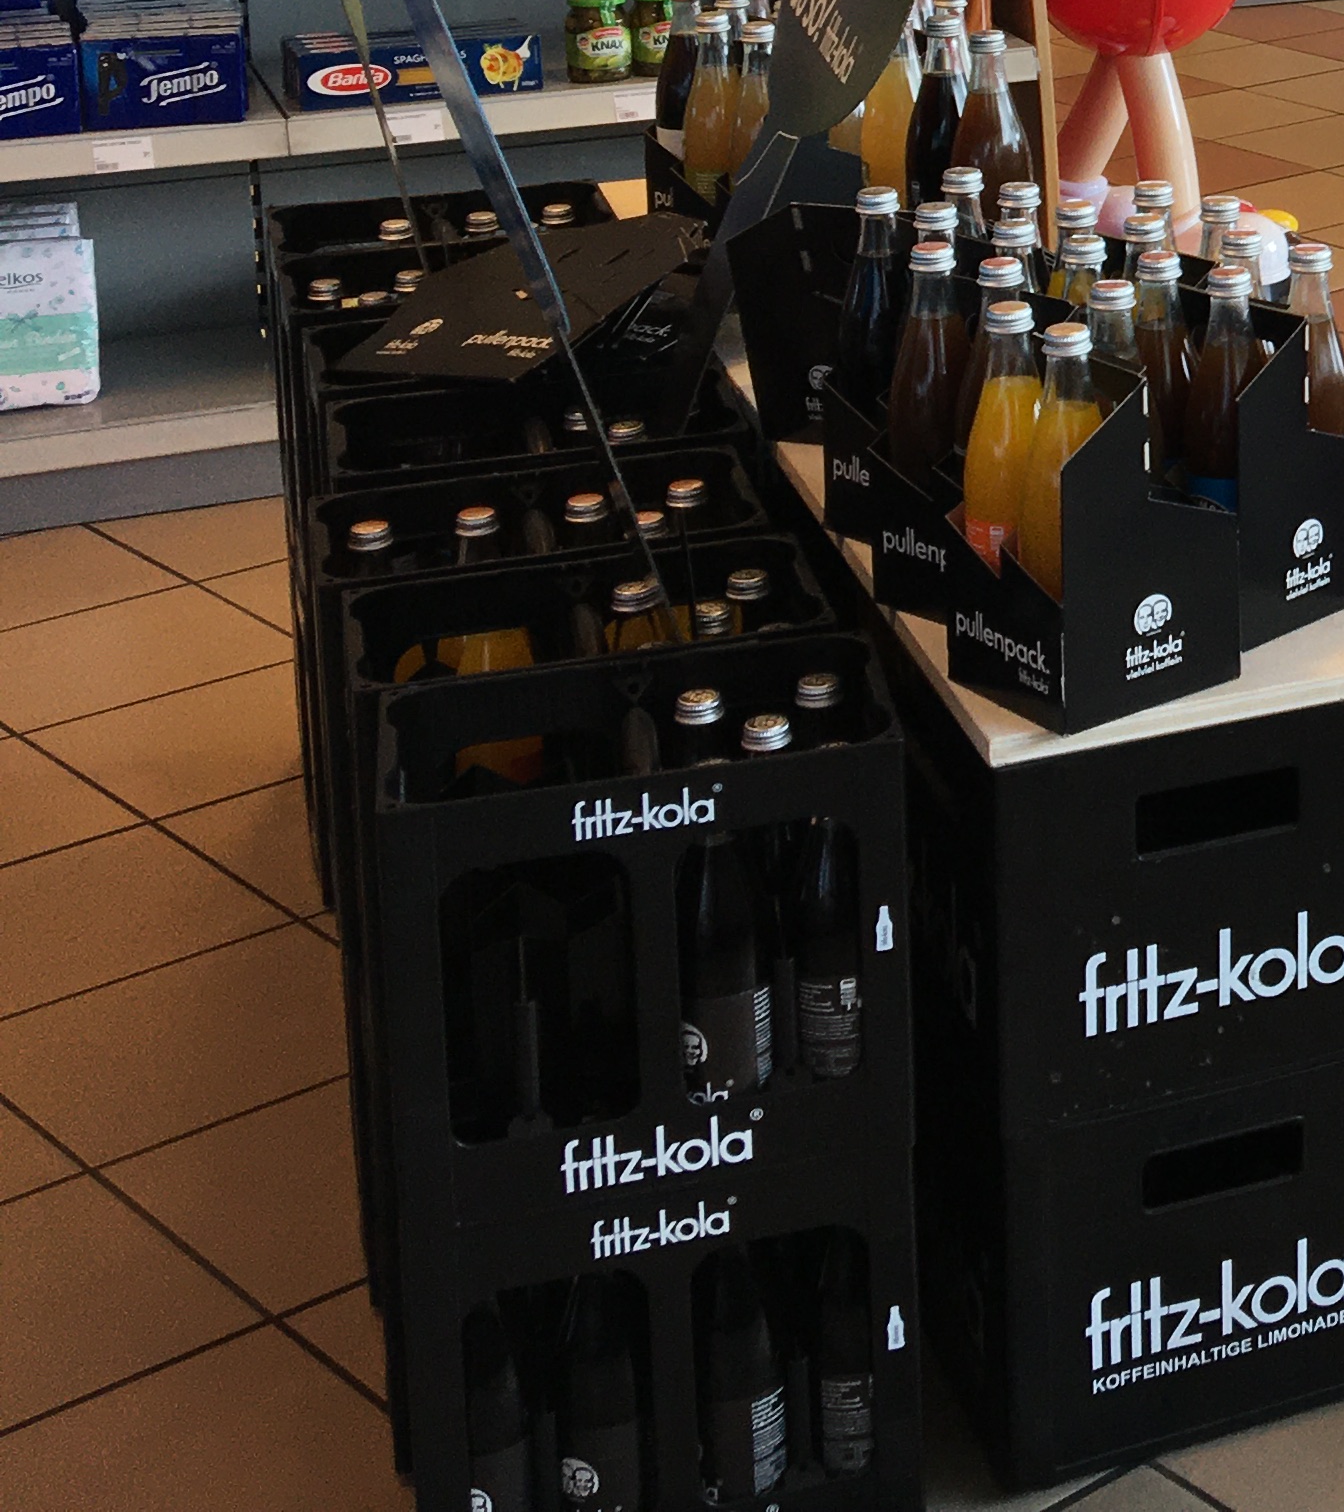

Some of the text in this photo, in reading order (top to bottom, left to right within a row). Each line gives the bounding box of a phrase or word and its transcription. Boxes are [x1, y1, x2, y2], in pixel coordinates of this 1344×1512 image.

[590, 39, 625, 52] KNAX
[653, 35, 670, 46] KN
[0, 81, 56, 110] empo
[141, 69, 220, 103] Tempo
[1285, 557, 1332, 592] fritz-kola
[954, 609, 1051, 677] pullenpack.
[1125, 634, 1184, 670] fritz-kola
[571, 787, 715, 842] fritz-kola
[560, 1115, 754, 1195] fritz-kola
[591, 1201, 731, 1260] fritz-kola
[1091, 1338, 1252, 1395] KOFFEINHALTIGE
